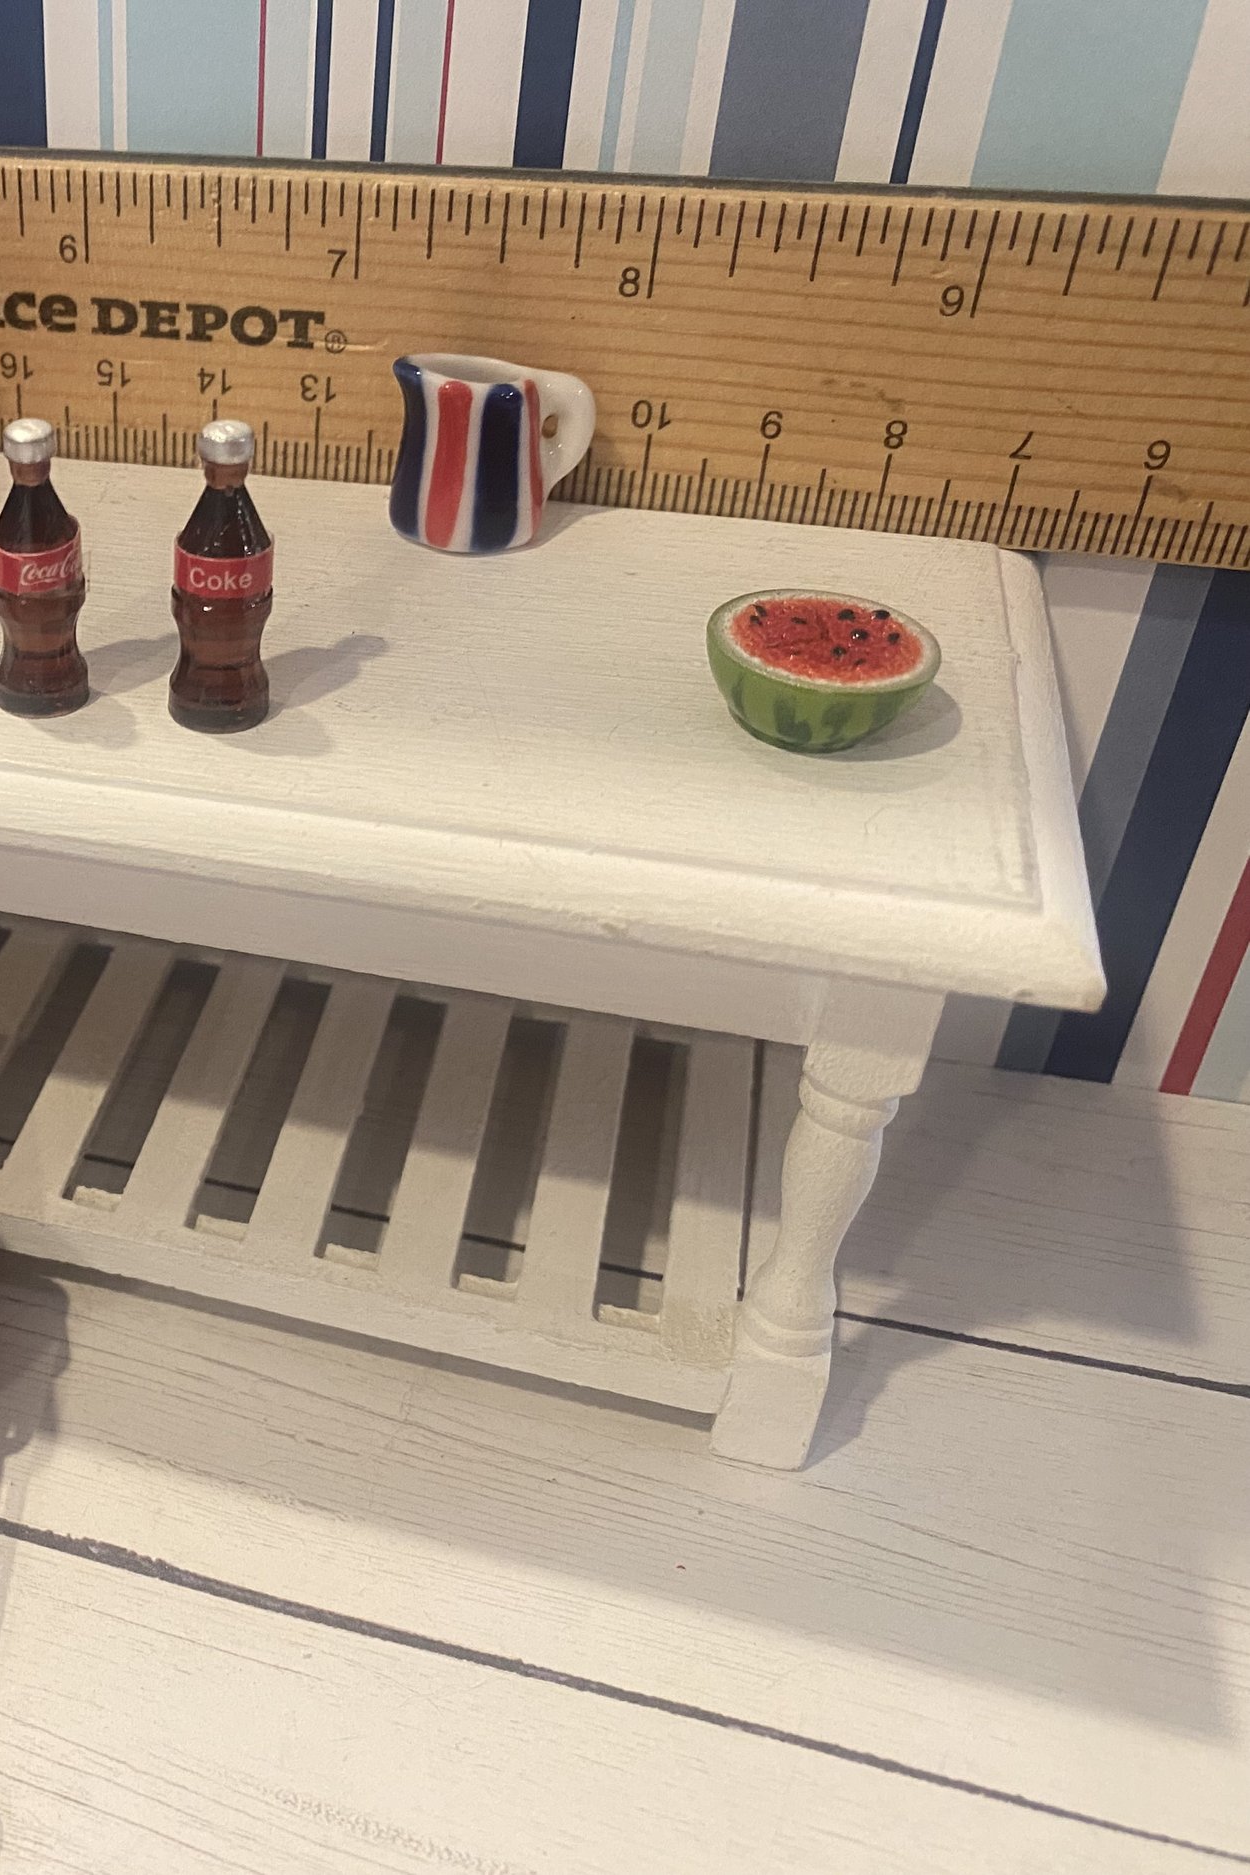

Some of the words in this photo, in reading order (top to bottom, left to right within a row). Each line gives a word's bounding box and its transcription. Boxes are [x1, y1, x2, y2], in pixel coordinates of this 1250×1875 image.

[59, 234, 78, 264] 6
[327, 249, 348, 279] 7
[618, 266, 641, 298] 8
[938, 285, 965, 317] 9
[0, 352, 35, 381] 16
[96, 358, 132, 389] 15
[197, 367, 233, 396] 14
[300, 374, 337, 404] 13
[631, 399, 672, 431] 10
[883, 418, 909, 450] 8
[1009, 430, 1035, 461] 7
[190, 567, 253, 591] Coke
